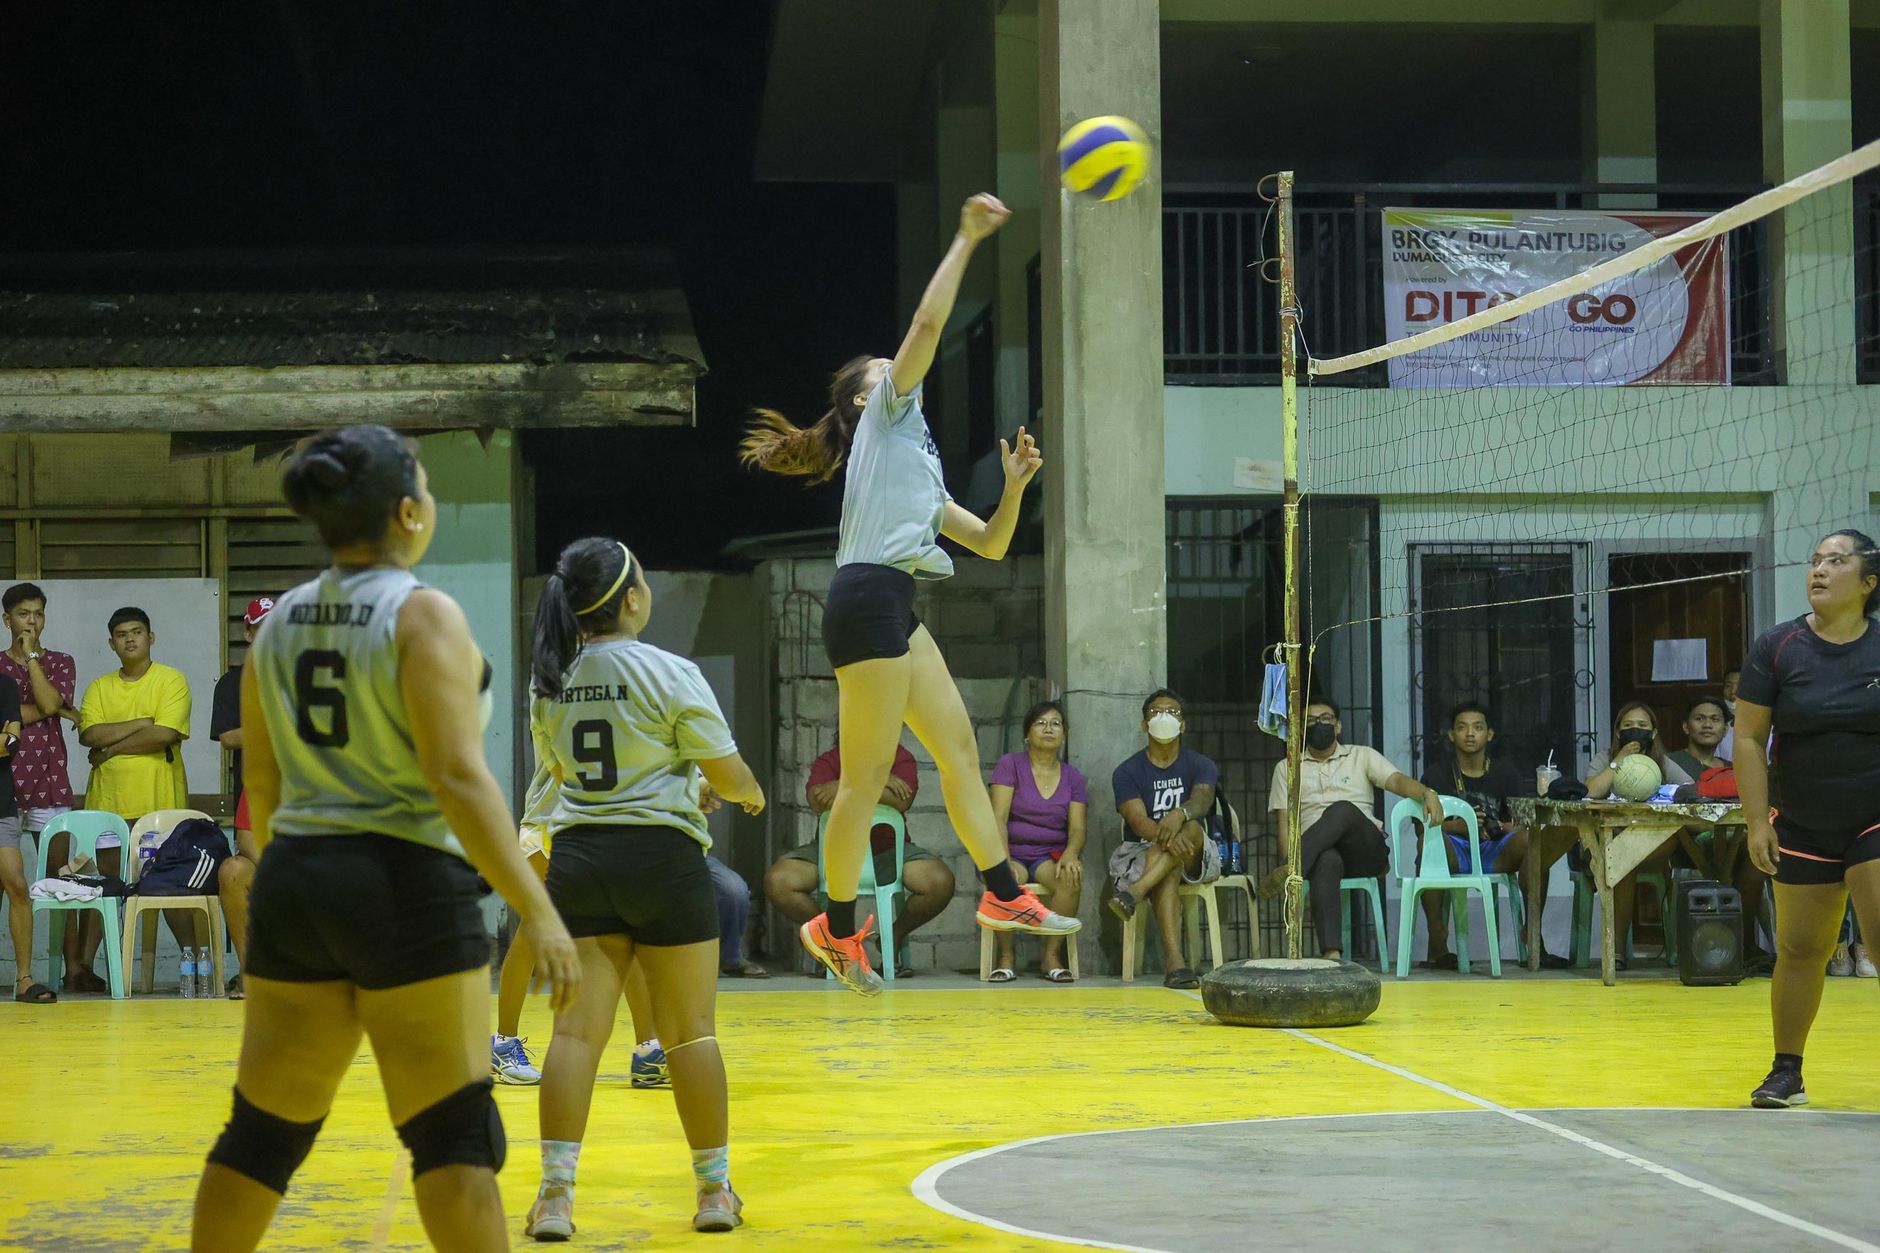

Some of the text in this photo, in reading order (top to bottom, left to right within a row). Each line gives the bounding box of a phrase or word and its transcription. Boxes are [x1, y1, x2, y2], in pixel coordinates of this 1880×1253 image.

[1469, 231, 1627, 253] PULANTUBIG
[1478, 253, 1507, 262] CITY
[1568, 293, 1636, 325] GO
[1569, 325, 1582, 333] GO
[296, 649, 350, 748] 6
[572, 719, 618, 792] 9
[1152, 786, 1184, 812] LOT
